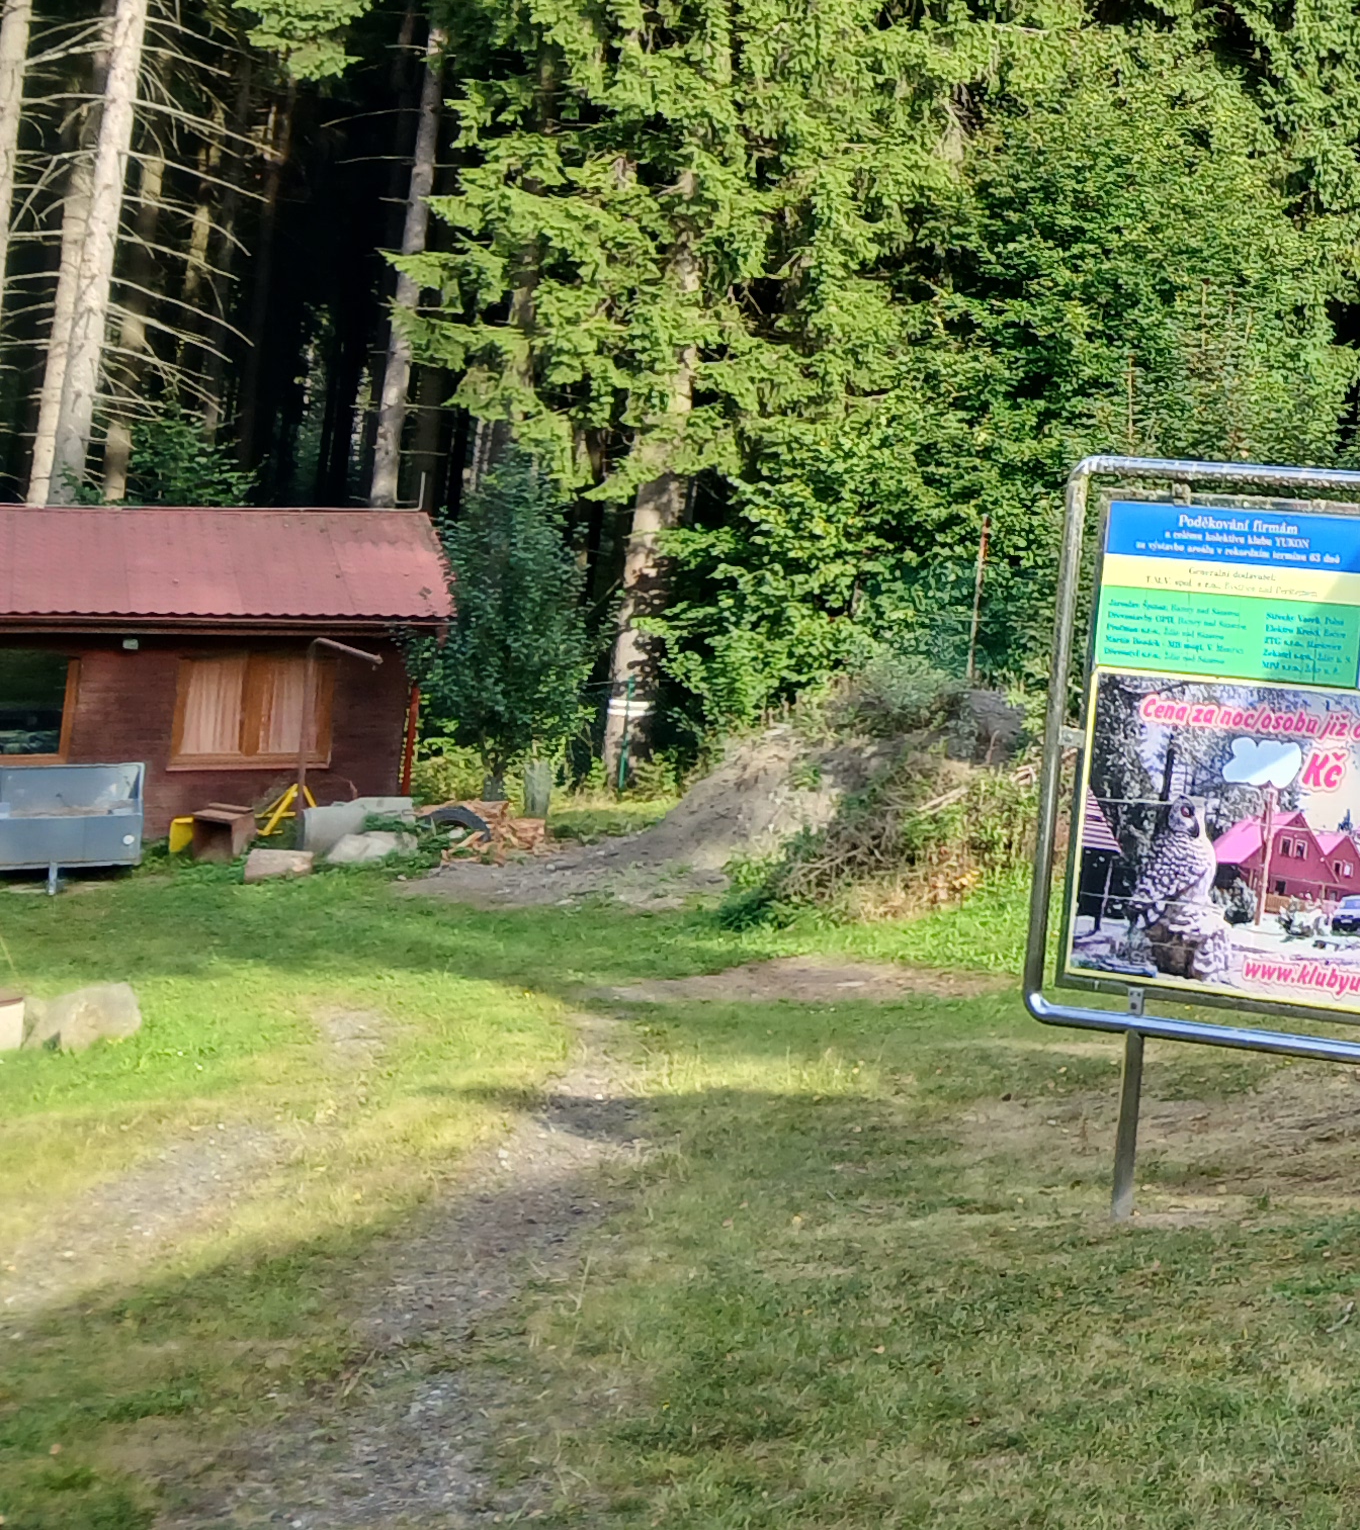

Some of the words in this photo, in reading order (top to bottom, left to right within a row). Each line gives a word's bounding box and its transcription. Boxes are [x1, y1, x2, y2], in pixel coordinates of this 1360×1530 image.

[1253, 518, 1298, 535] firmám
[1143, 698, 1187, 721] Cena
[1191, 707, 1212, 723] za
[1219, 707, 1318, 735] noc/osobu
[1318, 713, 1350, 741] již
[1302, 752, 1346, 787] Kč
